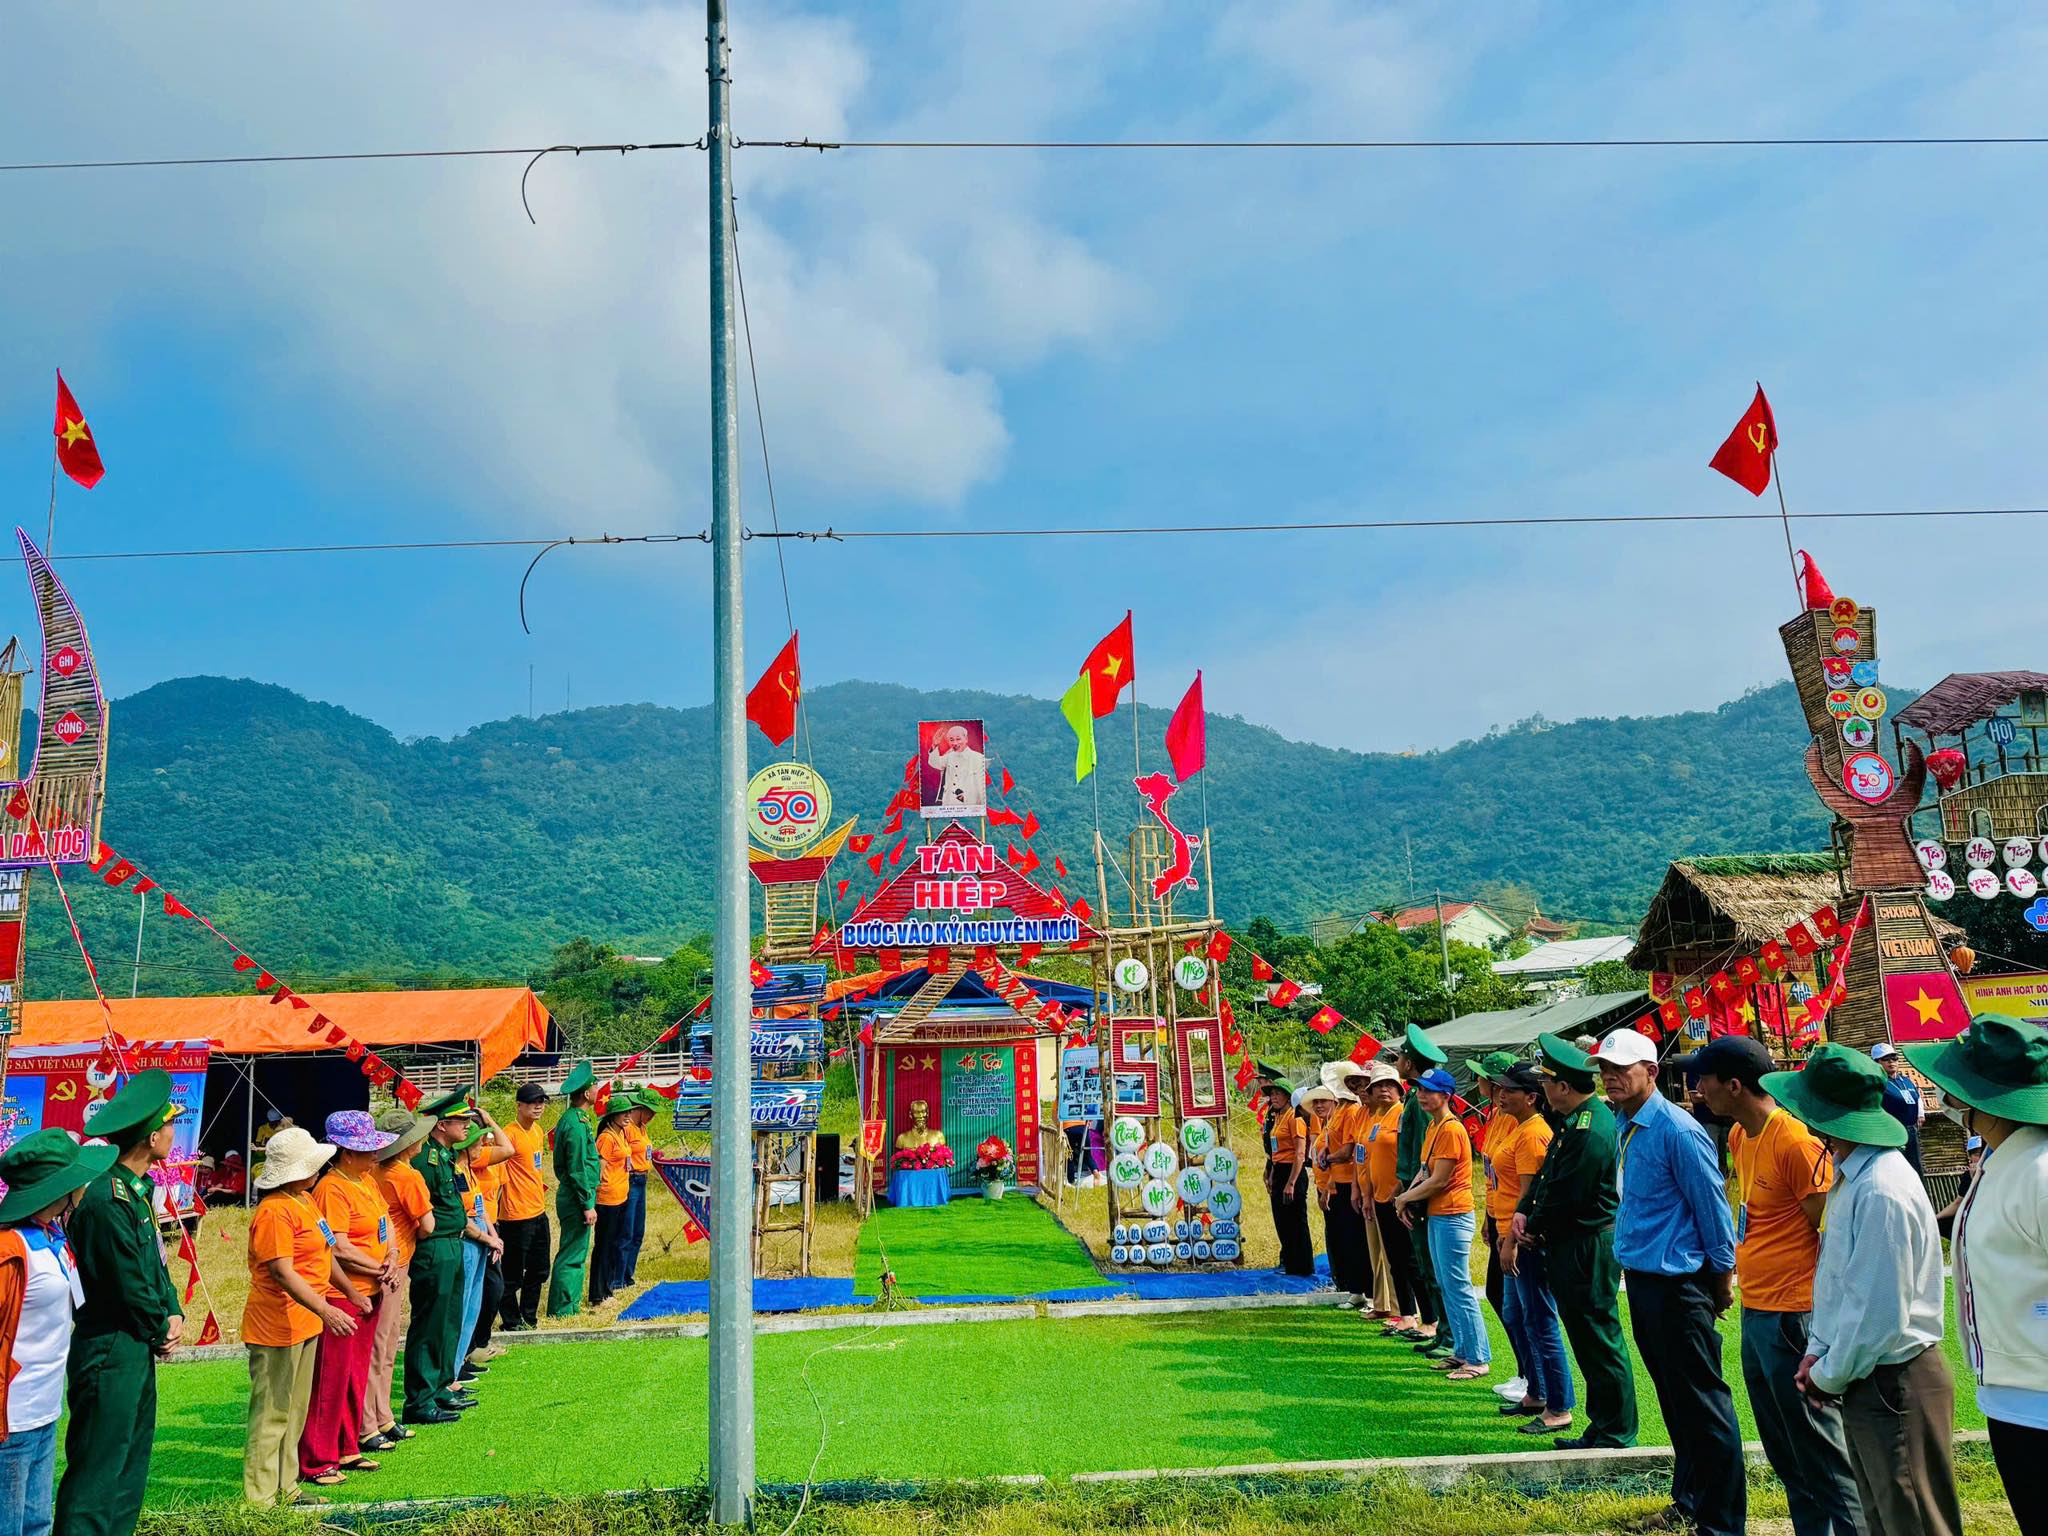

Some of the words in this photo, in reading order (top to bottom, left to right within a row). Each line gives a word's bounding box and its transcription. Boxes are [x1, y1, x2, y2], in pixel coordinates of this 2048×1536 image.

[58, 653, 74, 668] GHI
[57, 717, 83, 735] CÔNG
[1858, 773, 1880, 788] 50
[53, 824, 85, 861] TỘC
[916, 841, 996, 874] TÂN
[914, 875, 1008, 914] HIỆP
[842, 919, 896, 947] BƯỚC
[896, 922, 935, 946] VÀO
[935, 913, 962, 946] KỶ
[962, 916, 1040, 945] NGUYÊN
[1041, 913, 1079, 942] MỚI
[37, 1057, 60, 1071] VIỆT
[62, 1058, 84, 1069] NAM
[1147, 1224, 1167, 1237] 1975
[1215, 1223, 1236, 1235] 2025
[1114, 1248, 1125, 1260] 28
[1132, 1248, 1143, 1260] 03
[1179, 1245, 1190, 1256] 28
